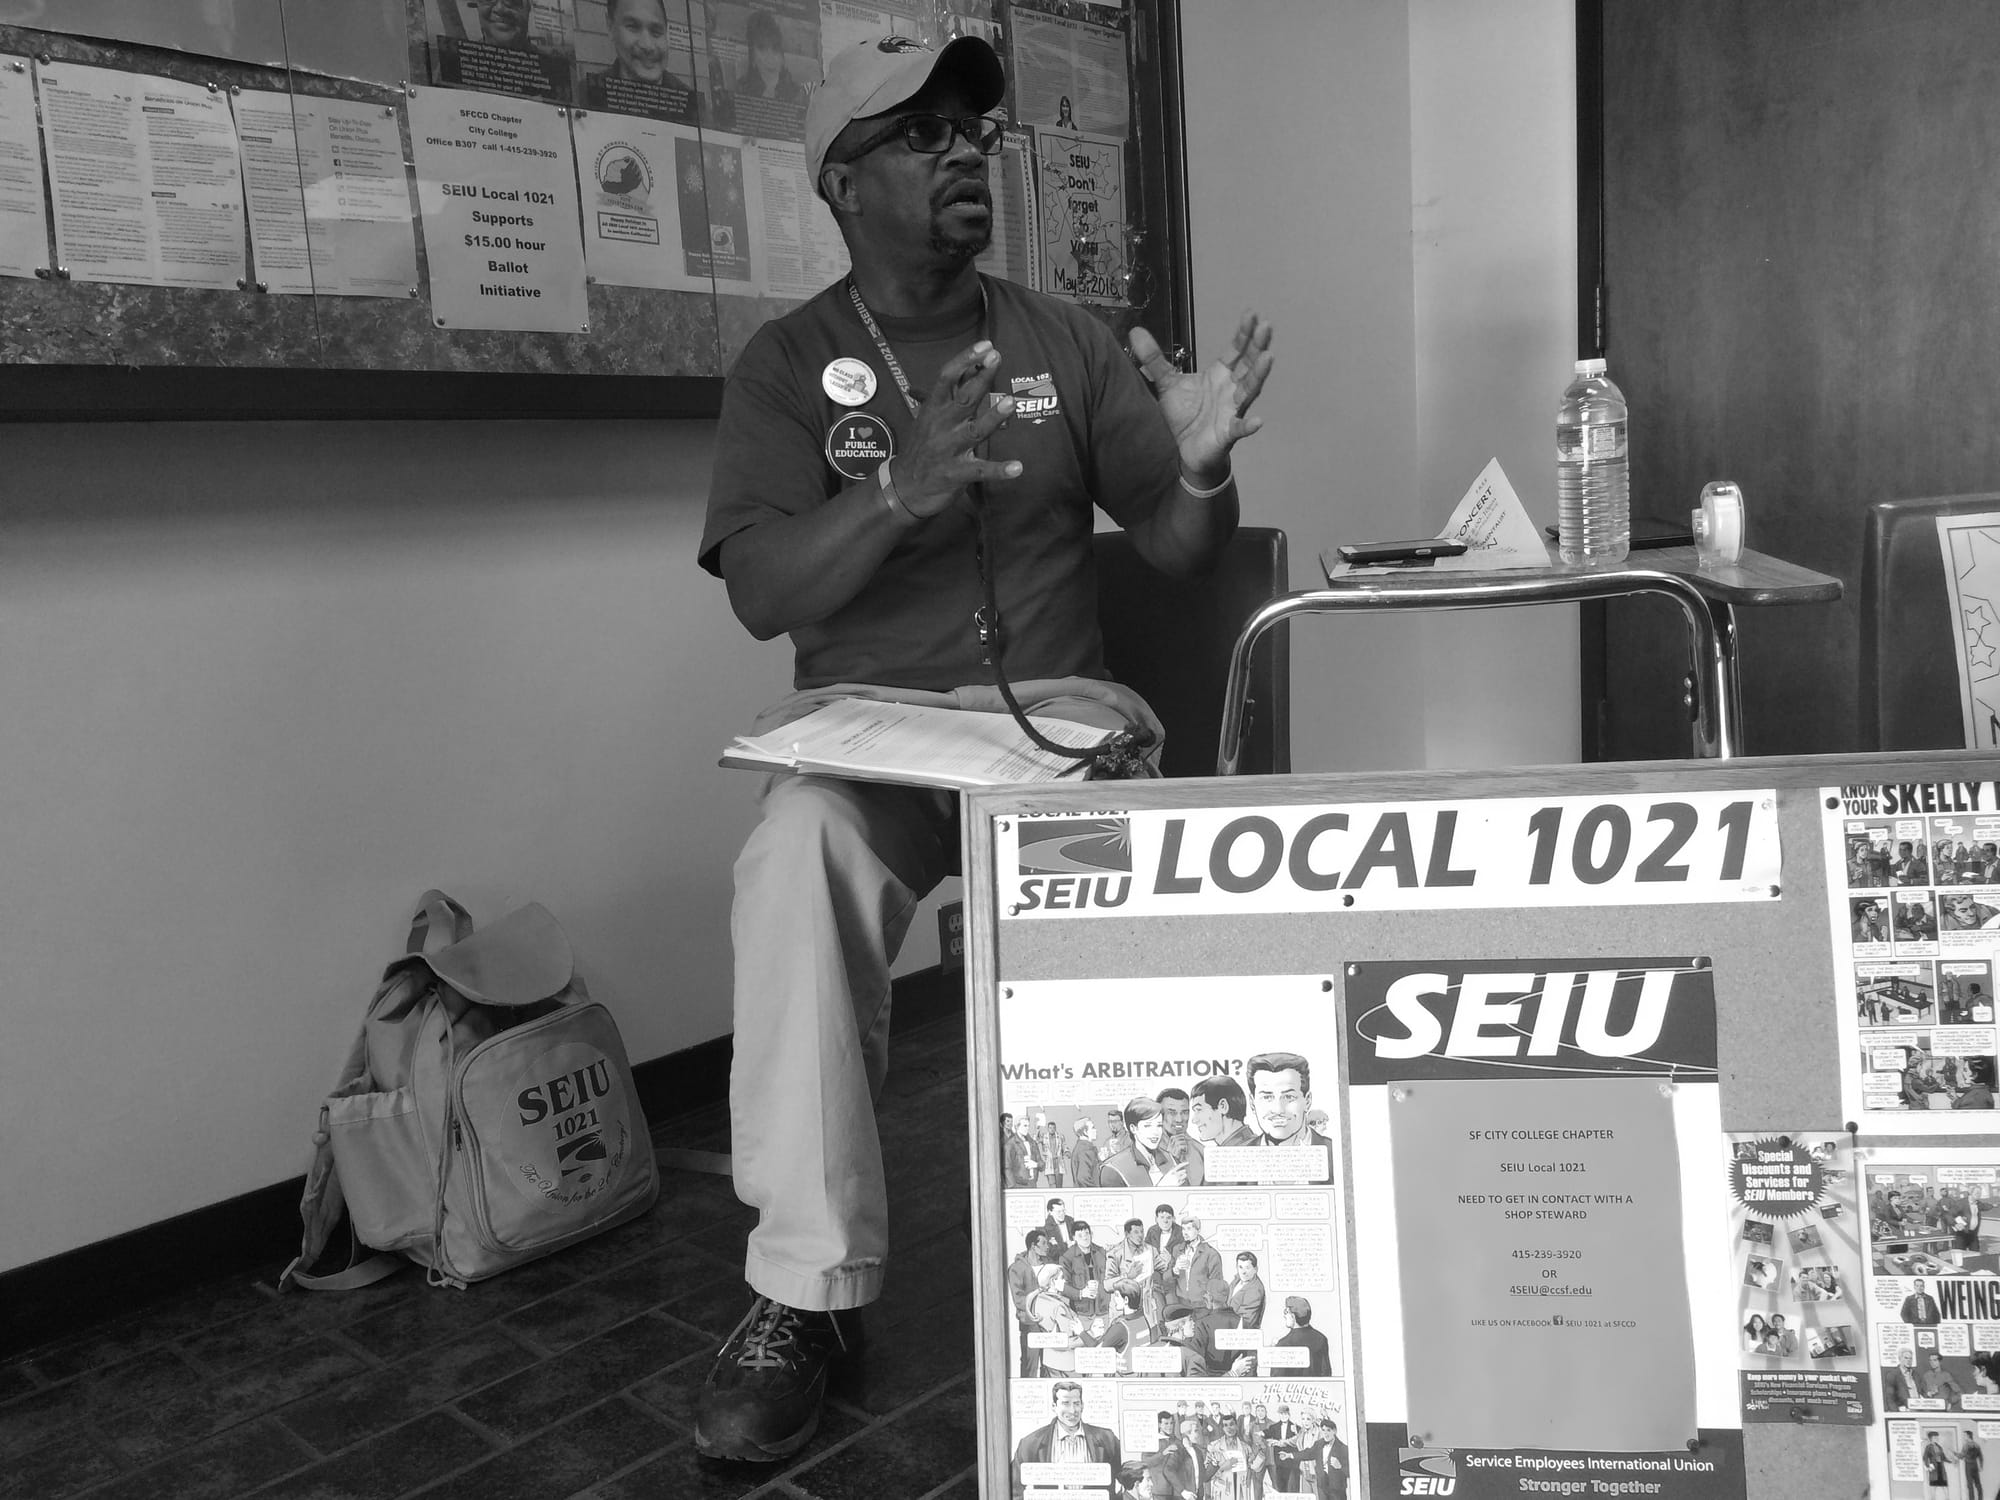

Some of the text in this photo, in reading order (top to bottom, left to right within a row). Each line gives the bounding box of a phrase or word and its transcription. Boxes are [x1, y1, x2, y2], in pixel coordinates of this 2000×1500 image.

[460, 109, 523, 125] SFCCD Chapter
[469, 125, 518, 140] City College
[426, 137, 453, 148] Office
[455, 139, 477, 150] B307
[482, 142, 498, 152] call
[1070, 154, 1090, 169] SEIU
[1068, 175, 1095, 191] Don't
[442, 183, 555, 205] SEIU Local 1021
[472, 210, 535, 227] Supports
[464, 234, 546, 252] $15.00 hour
[488, 260, 529, 274] Ballot
[1054, 267, 1077, 297] May
[480, 283, 541, 298] Initiative
[1016, 396, 1058, 413] SEIU
[1016, 411, 1042, 419] Health
[849, 427, 855, 440] I
[845, 441, 877, 449] PUBLIC
[835, 449, 886, 458] EDUCATION
[1840, 784, 1879, 799] KNOW
[1882, 782, 1981, 815] SKELLY
[1843, 799, 1878, 815] YOUR
[1153, 801, 1754, 895] LOCAL 1021
[1017, 876, 1132, 911] SEIU
[1375, 970, 1676, 1059] SEIU
[1001, 1058, 1243, 1081] What's ARBITRATION?
[517, 1059, 610, 1127] SEIU
[553, 1109, 600, 1141] 1021
[1469, 1129, 1614, 1140] SF CITY COLLEGE CHAPTER
[1758, 1150, 1794, 1164] Special
[1500, 1162, 1586, 1173] SEIU Local 1021
[1742, 1163, 1812, 1175] Discounts and
[1746, 1176, 1809, 1188] Services for
[1458, 1195, 1633, 1204] NEED TO GET IN CONTACT WITH A
[1744, 1188, 1814, 1201] SEIU Members
[1504, 1210, 1587, 1220] SHOP STEWARD
[1511, 1249, 1582, 1260] 415-239-3920
[1541, 1269, 1557, 1279] OR
[1509, 1285, 1593, 1296] 4SEIU@ccsf.edu
[1936, 1280, 2000, 1320] WEING
[1471, 1319, 1636, 1328] LIKE US ON FACEBOOK SEIU 1021 at SFCCD
[1466, 1454, 1714, 1472] Service Employees International Union
[1400, 1477, 1456, 1497] SEIU
[1519, 1477, 1662, 1496] Stronger Together
